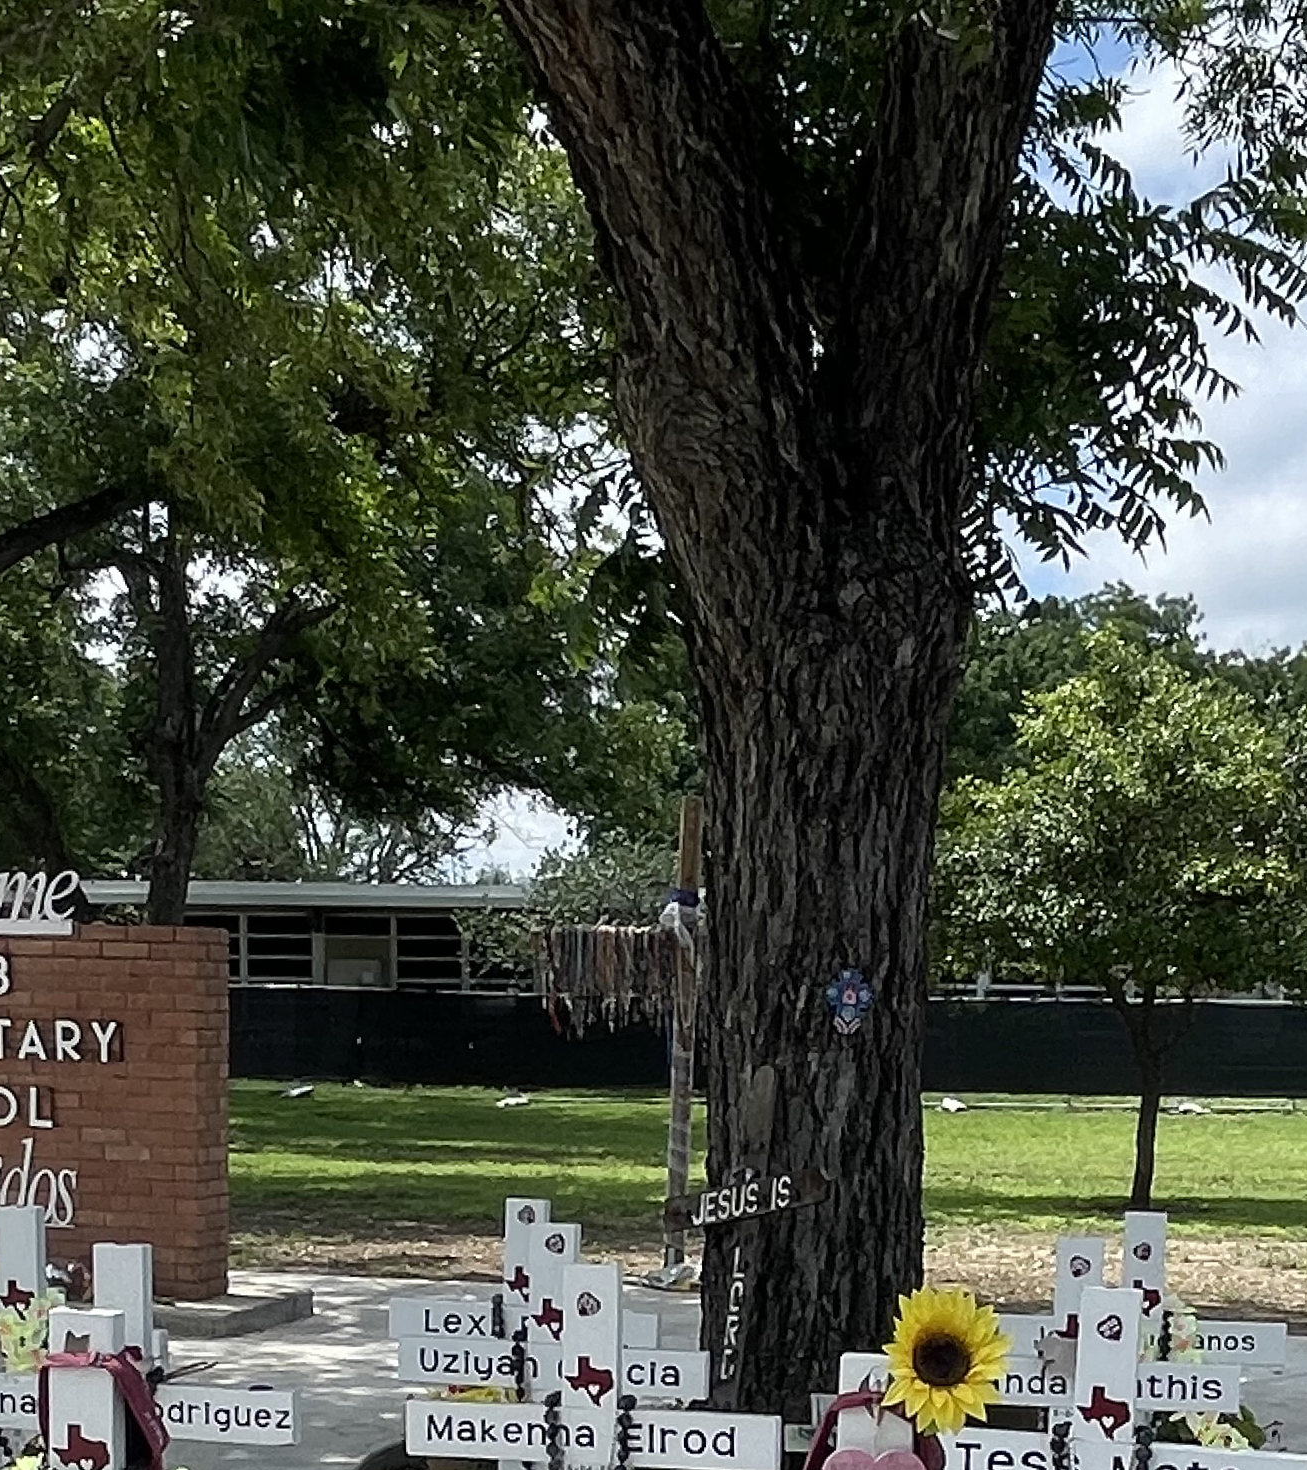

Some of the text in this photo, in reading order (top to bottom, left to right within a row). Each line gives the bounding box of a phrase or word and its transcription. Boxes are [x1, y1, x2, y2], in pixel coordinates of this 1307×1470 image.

[690, 1174, 792, 1226] JESUS IS
[424, 1308, 496, 1337] Lex
[624, 1423, 737, 1458] Elrod
